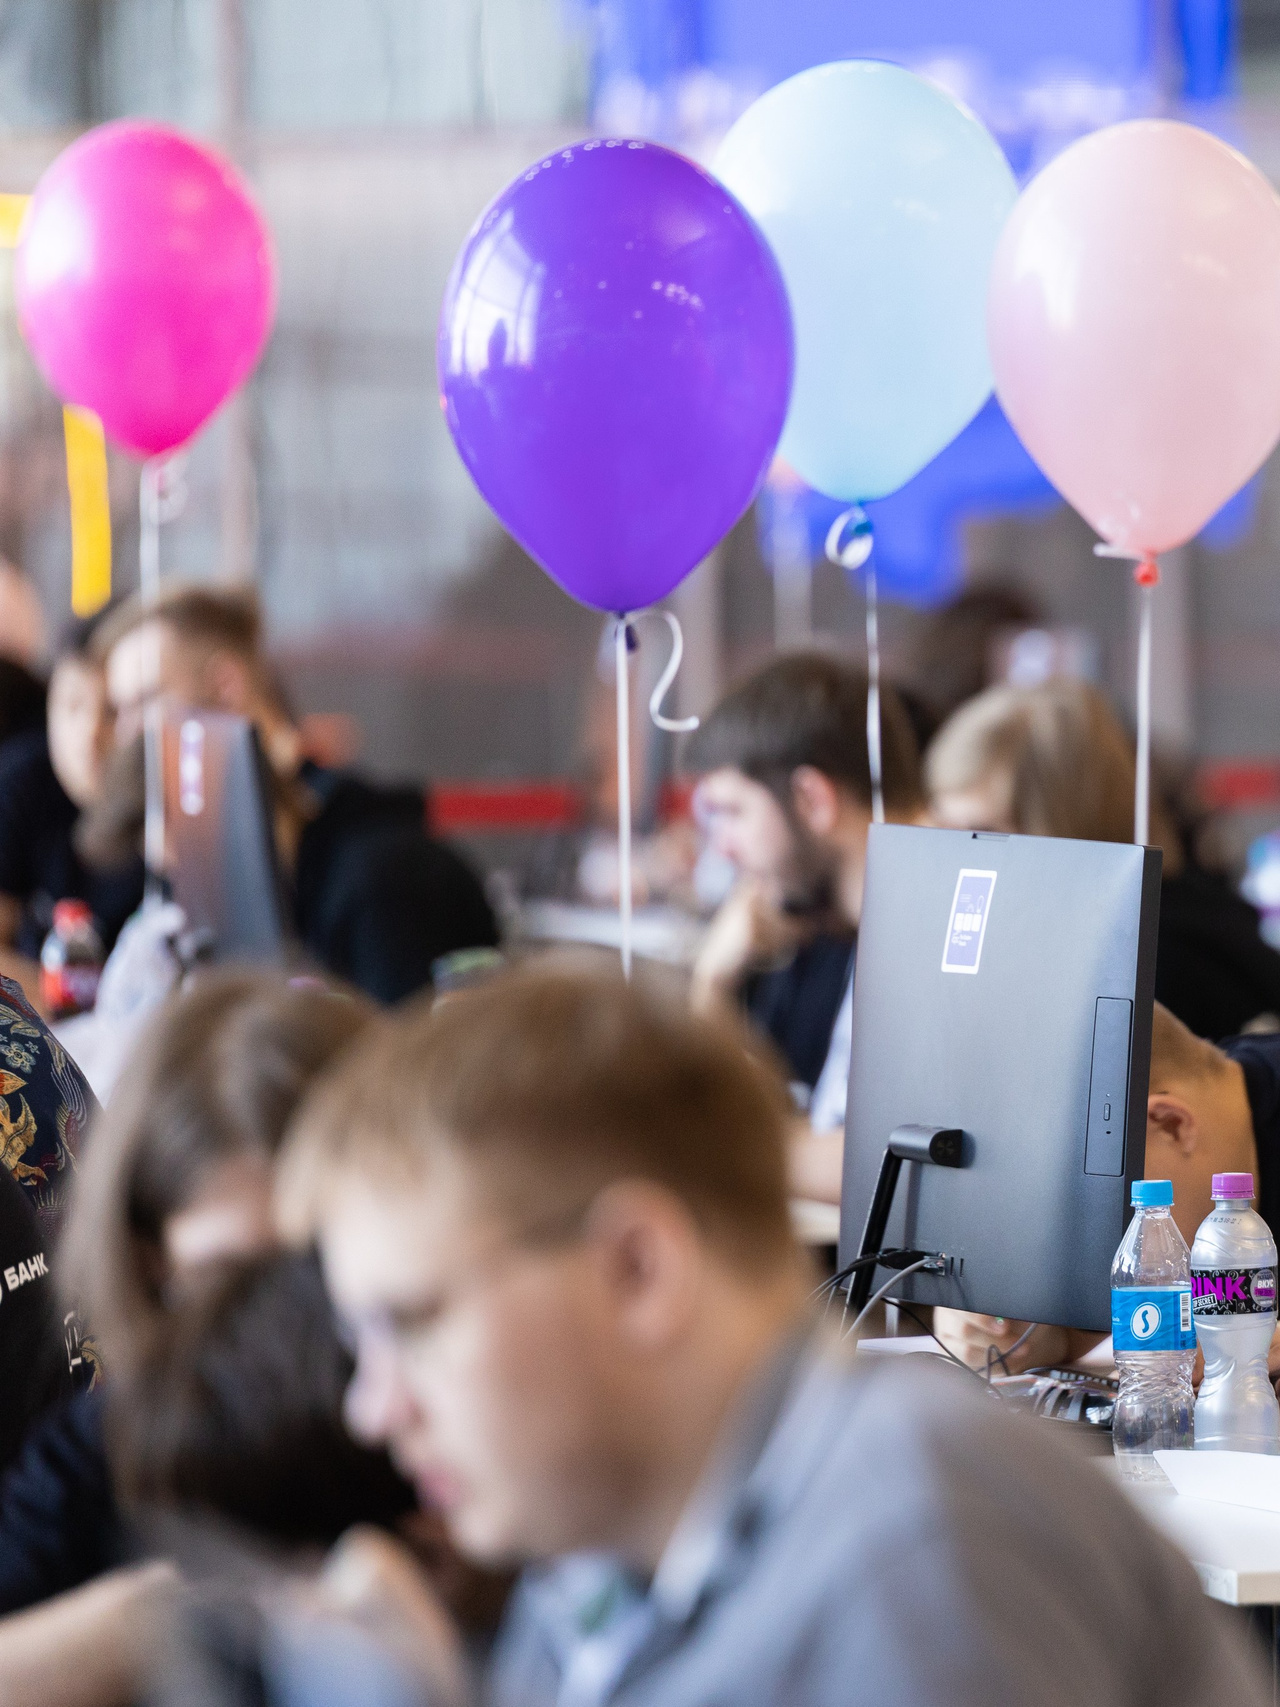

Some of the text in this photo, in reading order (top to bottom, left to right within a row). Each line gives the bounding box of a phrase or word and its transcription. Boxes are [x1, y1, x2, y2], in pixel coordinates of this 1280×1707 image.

[3, 1252, 49, 1292] БАНК
[1190, 1276, 1247, 1301] RINK
[1257, 1279, 1274, 1288] ВКУС
[1197, 1295, 1214, 1307] SECRET
